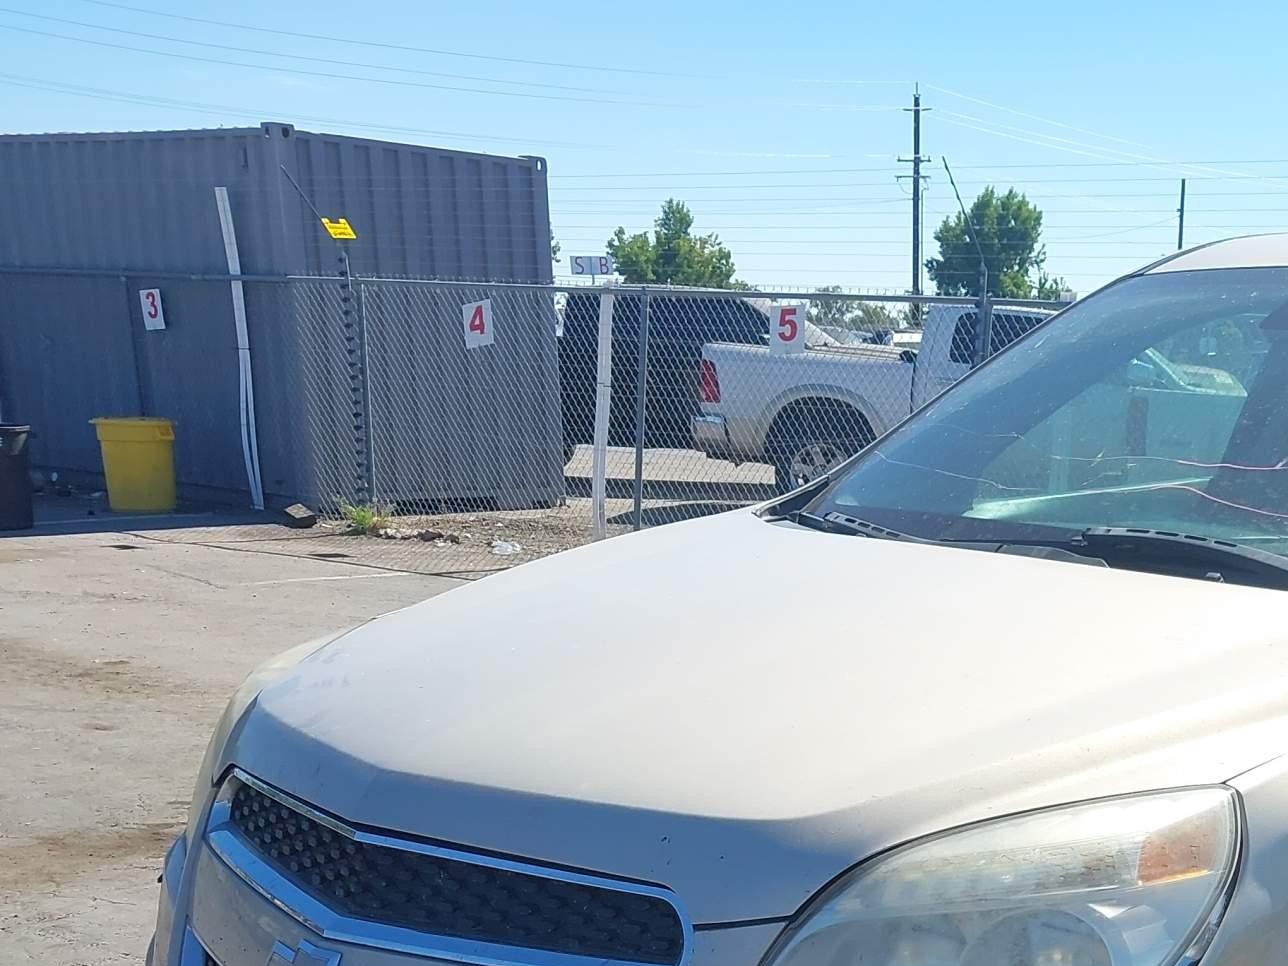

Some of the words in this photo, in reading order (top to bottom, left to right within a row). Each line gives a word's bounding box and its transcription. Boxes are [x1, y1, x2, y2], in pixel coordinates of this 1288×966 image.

[575, 256, 585, 275] S
[599, 256, 609, 275] B
[145, 291, 158, 319] 3
[469, 304, 485, 335] 4
[778, 307, 797, 342] 5
